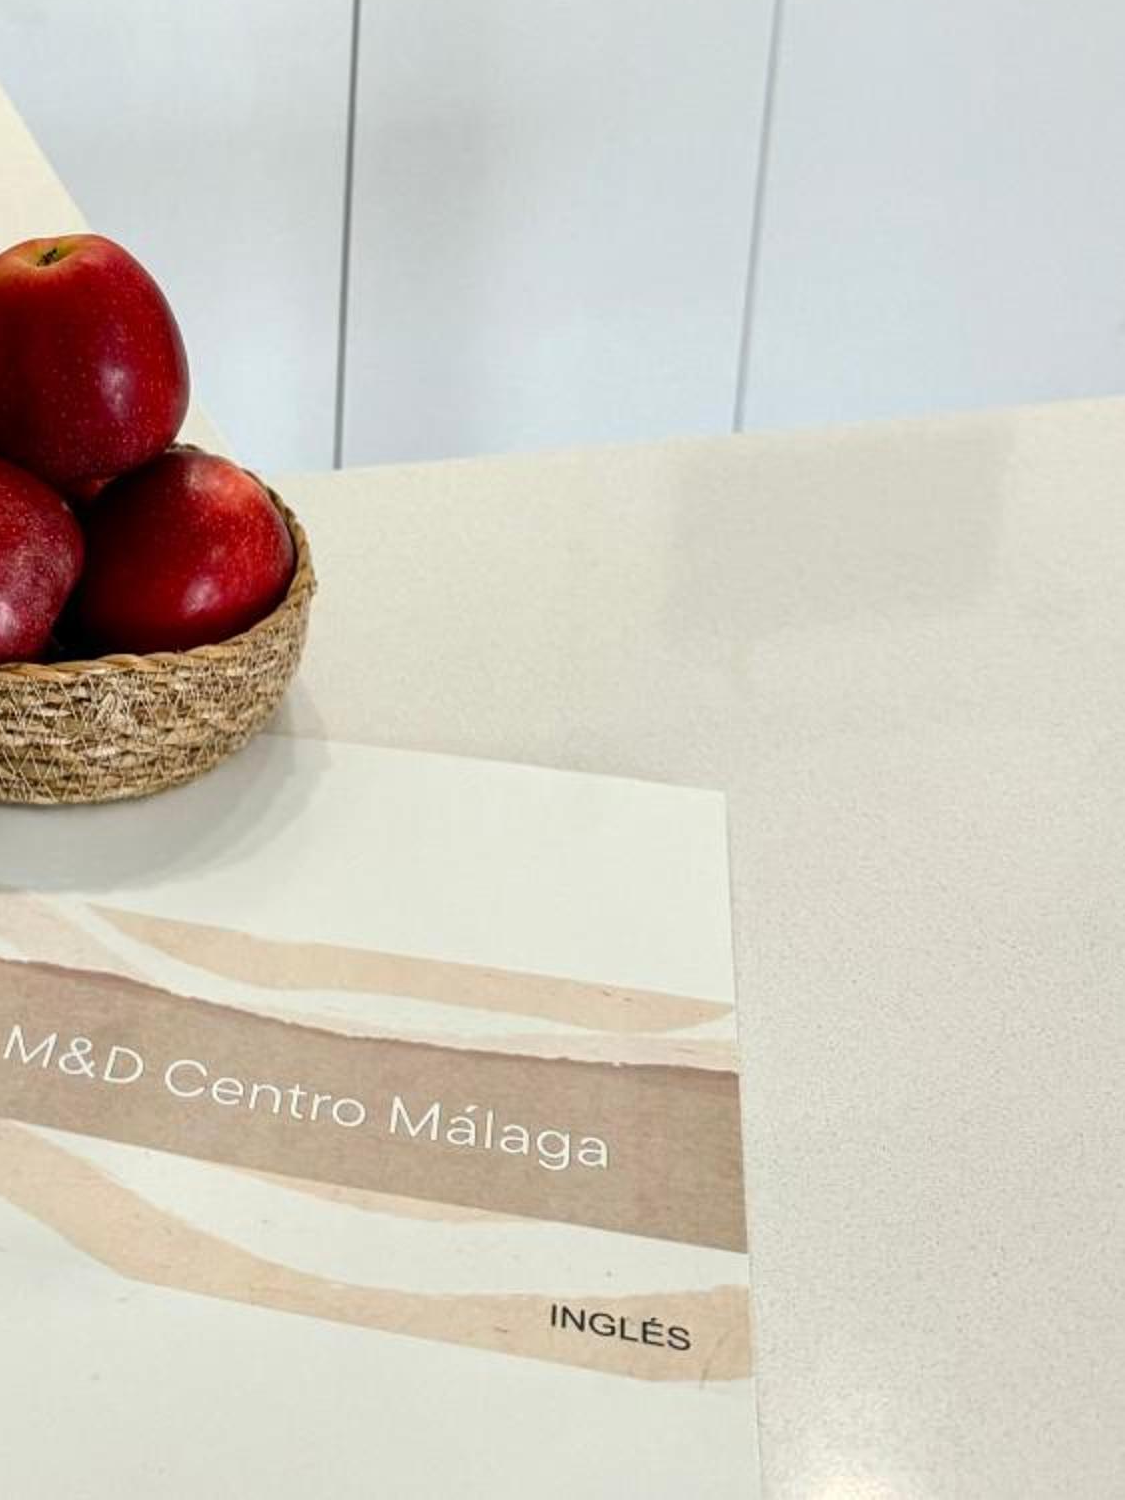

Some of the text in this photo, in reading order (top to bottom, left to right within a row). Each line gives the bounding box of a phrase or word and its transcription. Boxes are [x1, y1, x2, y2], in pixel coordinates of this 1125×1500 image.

[2, 1024, 610, 1171] M&D Centro Málaga
[550, 1303, 692, 1351] INGLÉS
